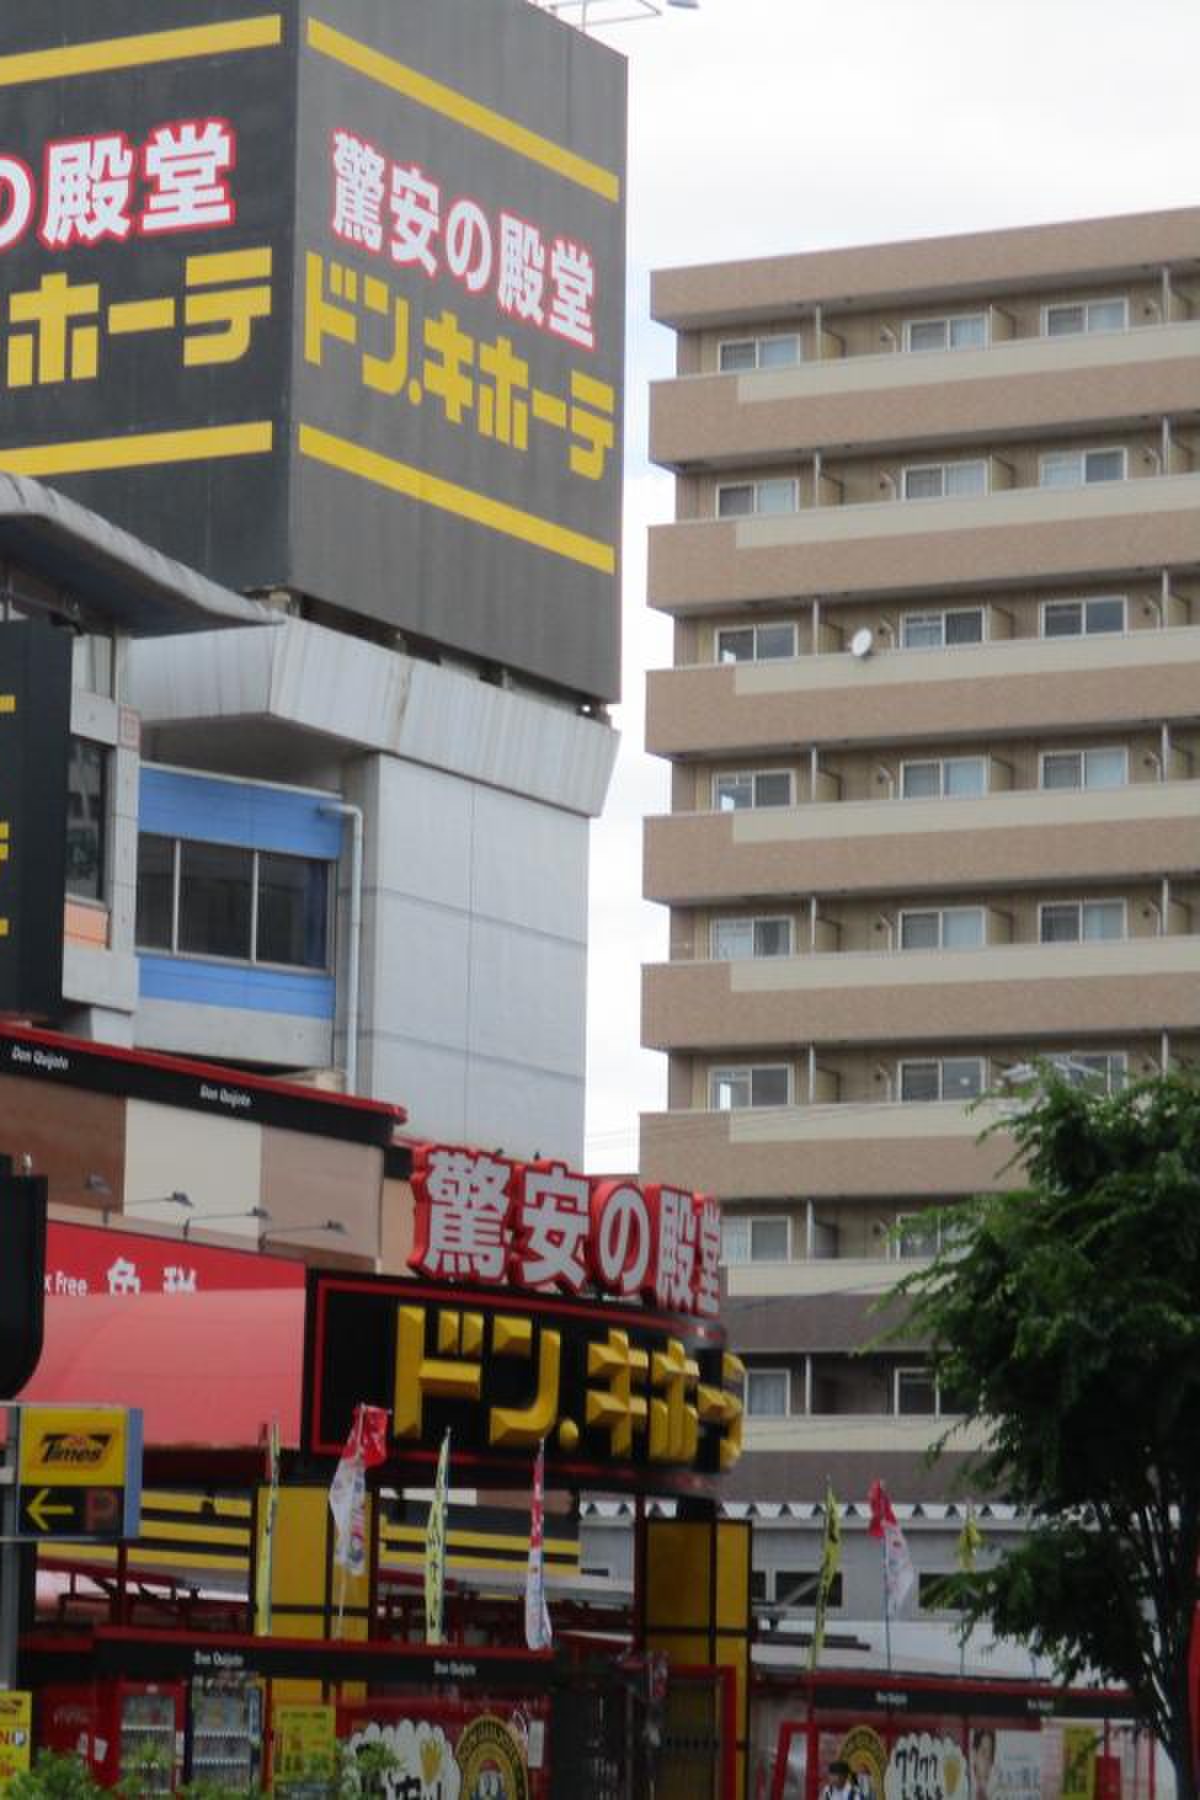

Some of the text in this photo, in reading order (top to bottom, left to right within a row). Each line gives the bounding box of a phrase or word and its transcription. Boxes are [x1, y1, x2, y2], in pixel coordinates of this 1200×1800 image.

[331, 129, 595, 352] 驚安の殿堂
[420, 1148, 722, 1316] 驚安の殿堂
